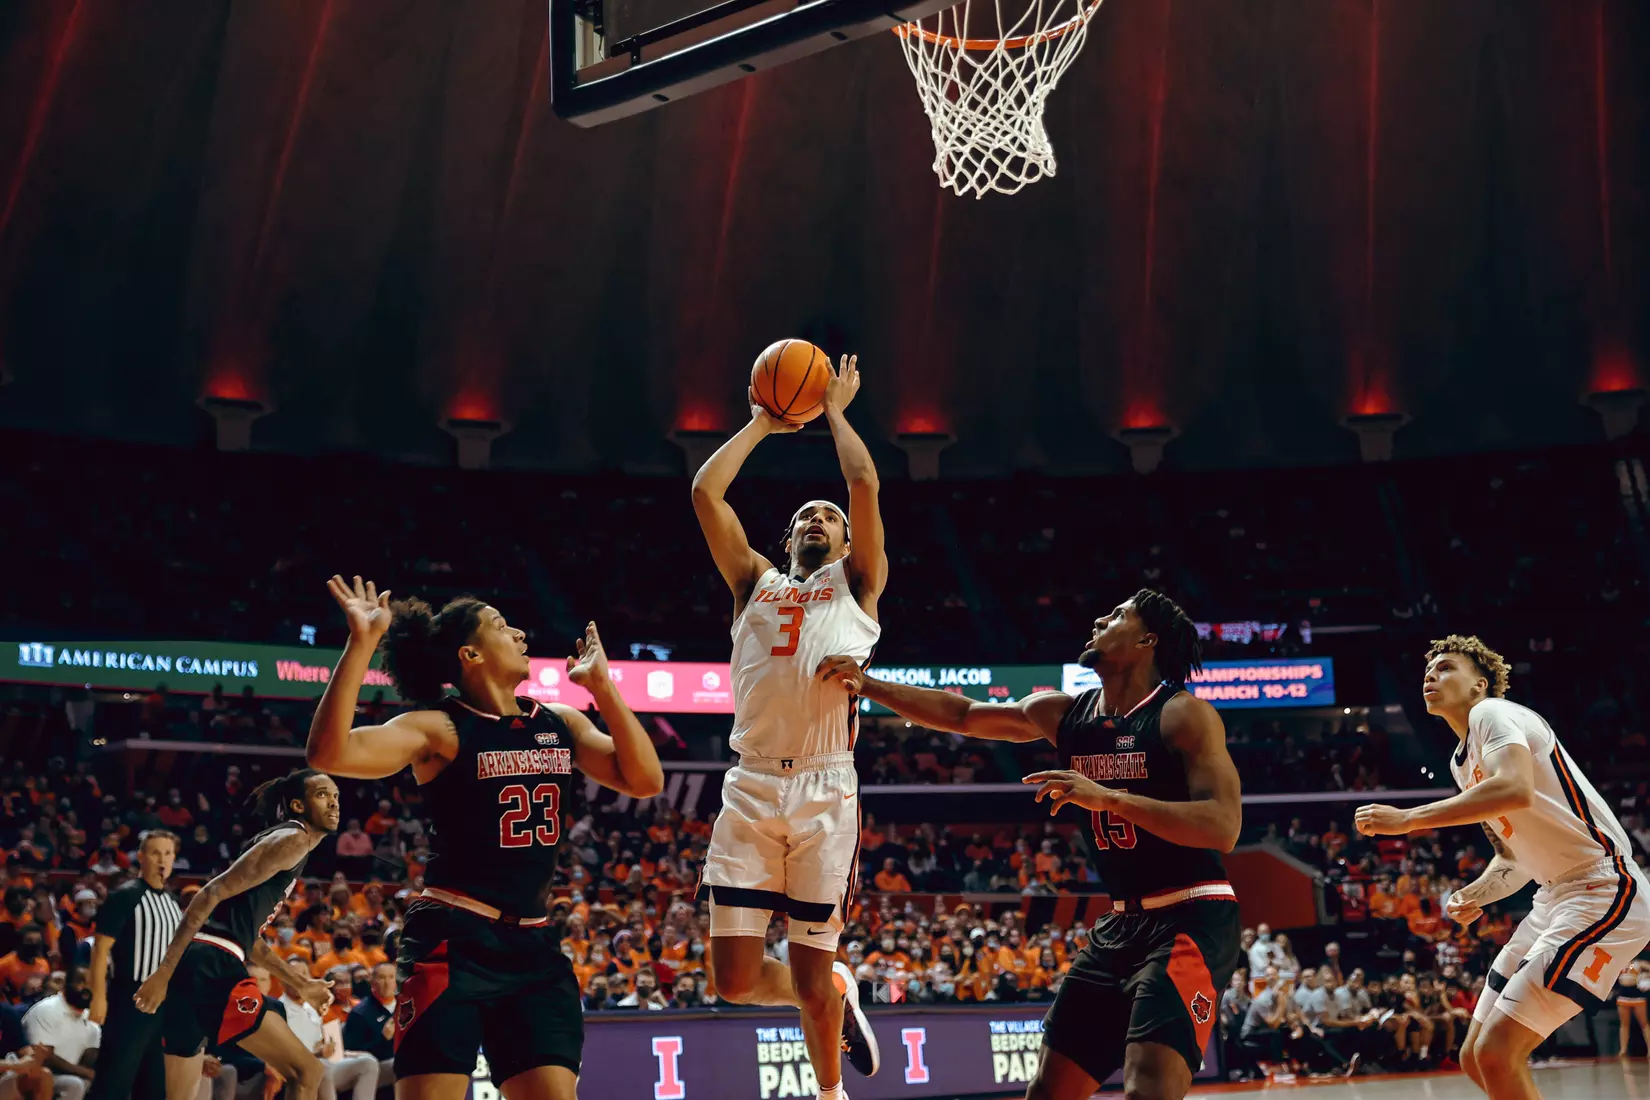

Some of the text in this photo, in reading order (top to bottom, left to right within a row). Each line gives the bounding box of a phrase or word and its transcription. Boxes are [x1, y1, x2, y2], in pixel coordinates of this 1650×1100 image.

[754, 587, 834, 604] ILLINOIS
[771, 606, 805, 656] 3
[58, 648, 259, 677] AMERICAN CAMPUS
[276, 660, 330, 683] Where
[865, 667, 992, 687] NDISON, JACOB
[1194, 683, 1308, 700] MARCH 10-12
[1116, 735, 1136, 749] SBC
[478, 748, 572, 780] ARKANSAS STATE
[1115, 752, 1148, 779] STATE
[499, 783, 560, 848] 23
[1091, 789, 1137, 850] 15
